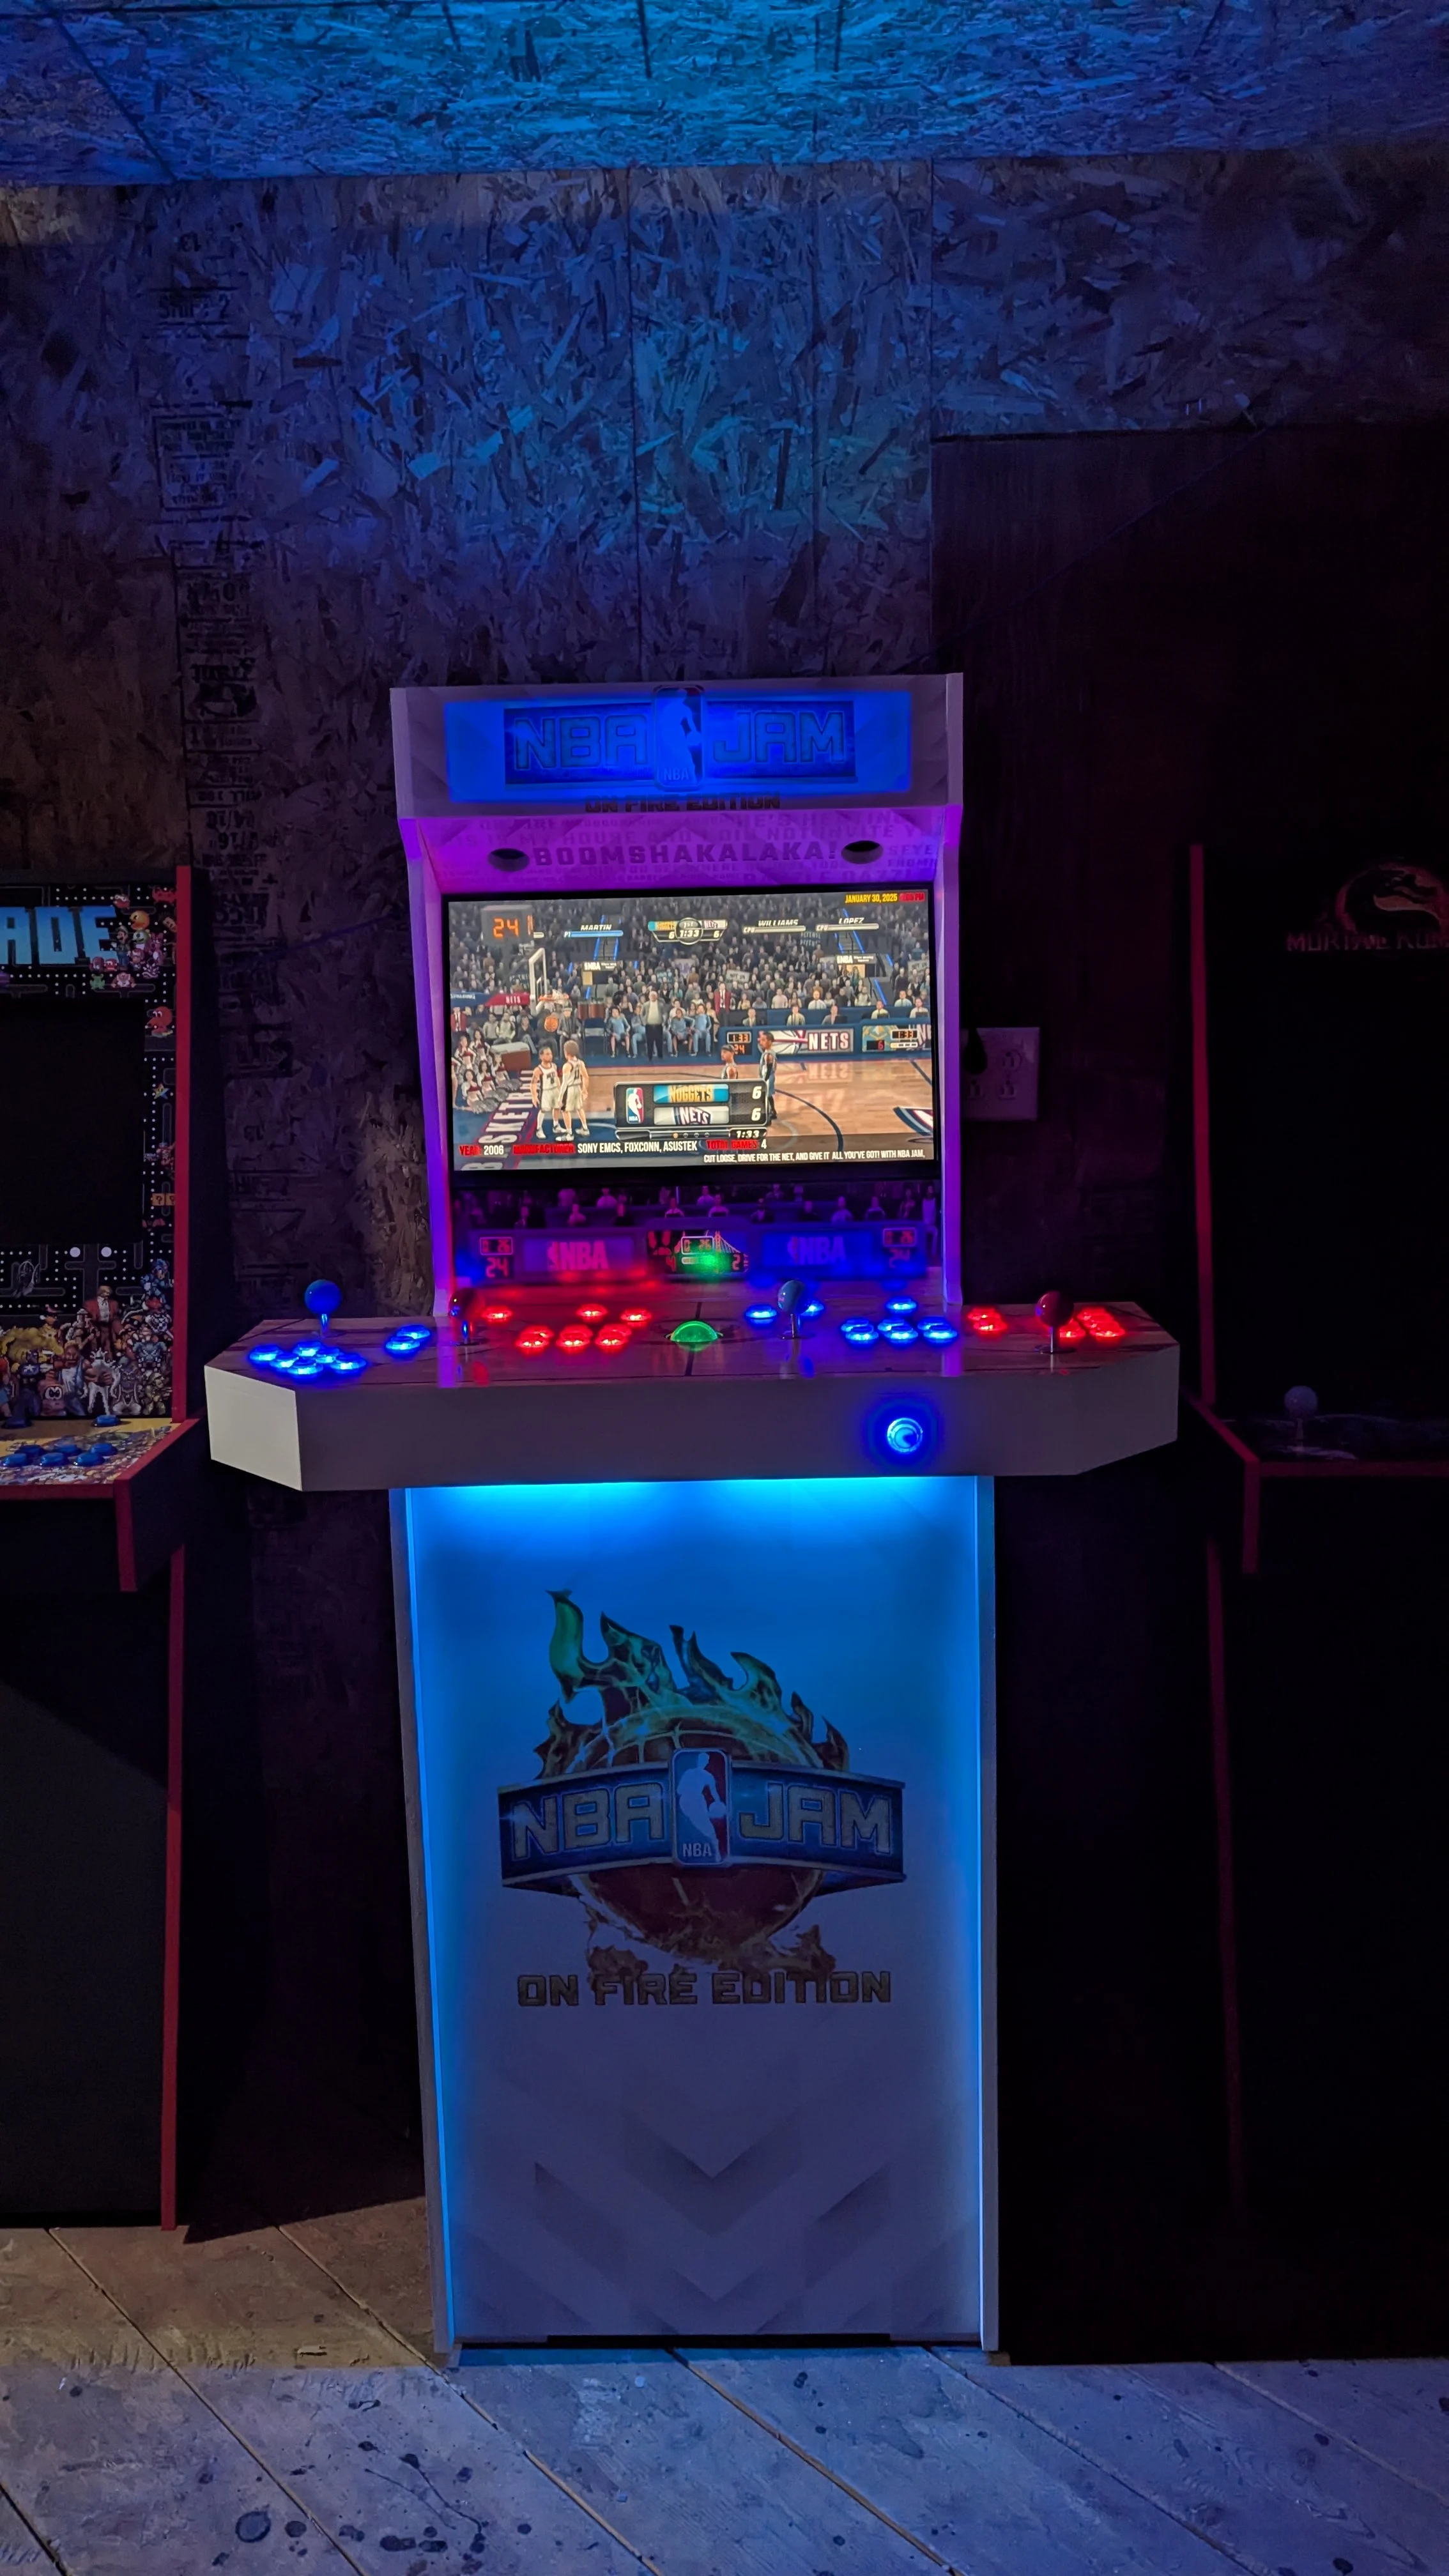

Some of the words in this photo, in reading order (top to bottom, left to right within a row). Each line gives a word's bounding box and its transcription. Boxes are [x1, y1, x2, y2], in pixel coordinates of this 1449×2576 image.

[514, 714, 649, 769] NBA
[713, 711, 845, 763] JAM
[664, 768, 690, 781] NBA
[585, 796, 618, 813] ON
[624, 794, 680, 812] FIRE
[687, 792, 780, 811] EDITION
[533, 841, 836, 866] BOOMSHAKALAKA!
[845, 893, 871, 903] JANUARY
[872, 893, 881, 903] 30,
[493, 918, 519, 939] 24
[733, 1032, 749, 1042] 1:33
[808, 1031, 850, 1050] NETS
[878, 1041, 884, 1050] 6
[670, 1085, 712, 1103] NUGGETS
[752, 1085, 762, 1100] 6
[679, 1106, 710, 1125] NETS
[751, 1108, 761, 1121] 6
[736, 1130, 760, 1138] 1:33
[484, 1144, 504, 1156] 2006
[578, 1142, 598, 1154] SONY
[599, 1142, 624, 1154] EMCS,
[624, 1141, 662, 1153] FOXCONN,
[663, 1140, 698, 1152] ASUSTEK
[761, 1140, 767, 1149] 4
[704, 1154, 716, 1163] CUT
[717, 1154, 737, 1163] LOOSE,
[738, 1154, 756, 1162] DRIVE
[756, 1153, 769, 1162] FOR
[769, 1153, 781, 1161] THE
[782, 1153, 795, 1162] NET,
[795, 1152, 808, 1161] AND
[809, 1152, 823, 1160] GIVE
[824, 1151, 830, 1160] IT
[832, 1151, 843, 1160] ALL
[844, 1151, 865, 1159] YOU'VE
[866, 1151, 880, 1159] GOT!
[881, 1150, 896, 1158] WITH
[897, 1149, 910, 1158] NBA
[558, 1241, 609, 1270] NBA
[798, 1236, 847, 1266] NBA
[486, 1257, 509, 1277] 24
[512, 1781, 664, 1860] NBA
[739, 1781, 892, 1855] JAM
[682, 1843, 713, 1858] NBA
[518, 1974, 578, 2006] ON
[594, 1973, 698, 2005] FIRE
[711, 1971, 892, 2005] EDITION
